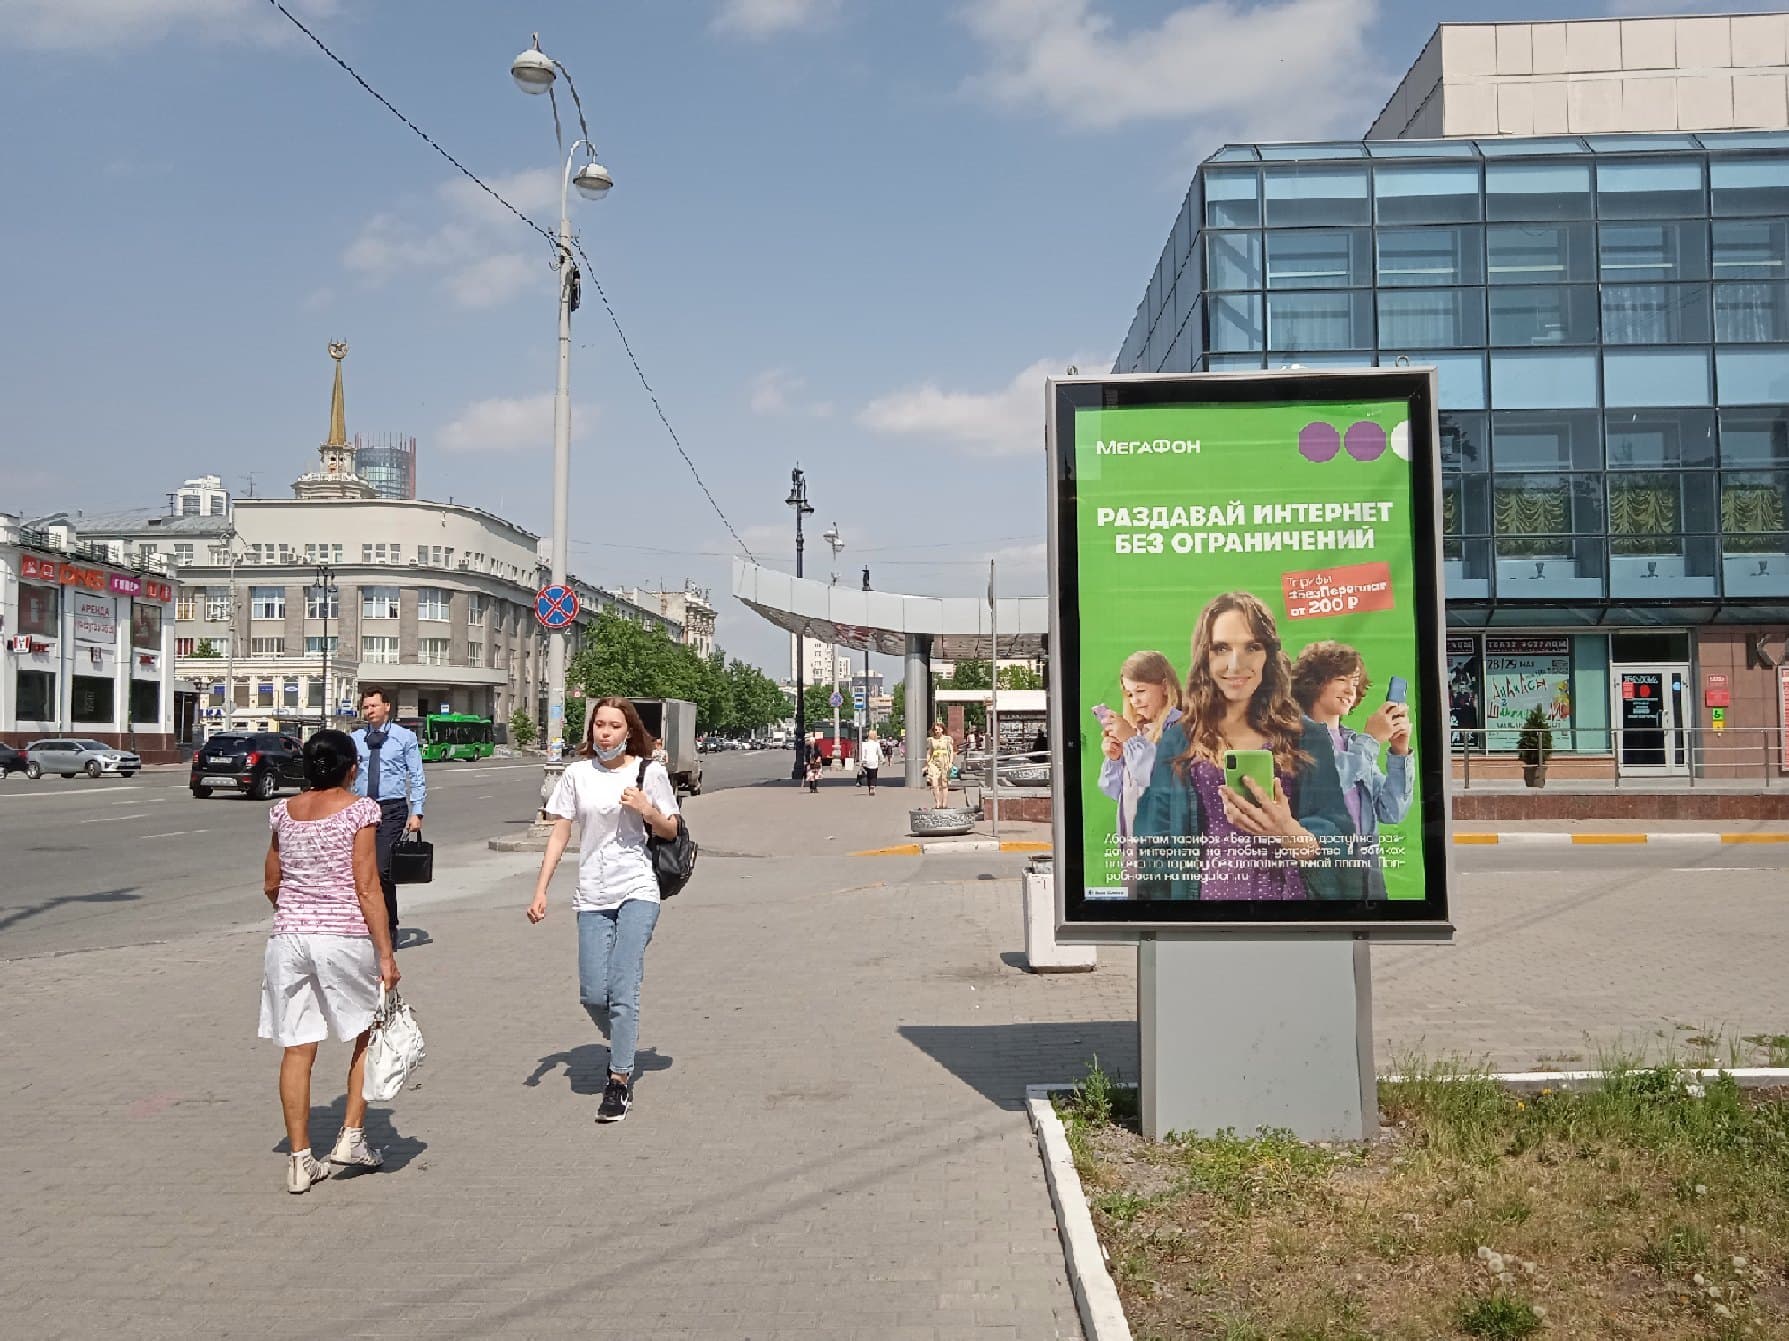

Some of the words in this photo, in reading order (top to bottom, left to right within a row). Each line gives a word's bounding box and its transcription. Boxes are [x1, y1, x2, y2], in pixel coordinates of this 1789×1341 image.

[1097, 500, 1246, 530] РАЗДАВАЙ
[1254, 501, 1394, 526] ИНТЕРНЕТ
[1115, 533, 1164, 554] БЕЗ
[1171, 526, 1375, 554] ОГРАНИЧЕНИЙ
[81, 604, 110, 616] АРЕНДА
[1290, 607, 1306, 616] от
[1308, 598, 1344, 614] 200
[1206, 848, 1221, 857] на
